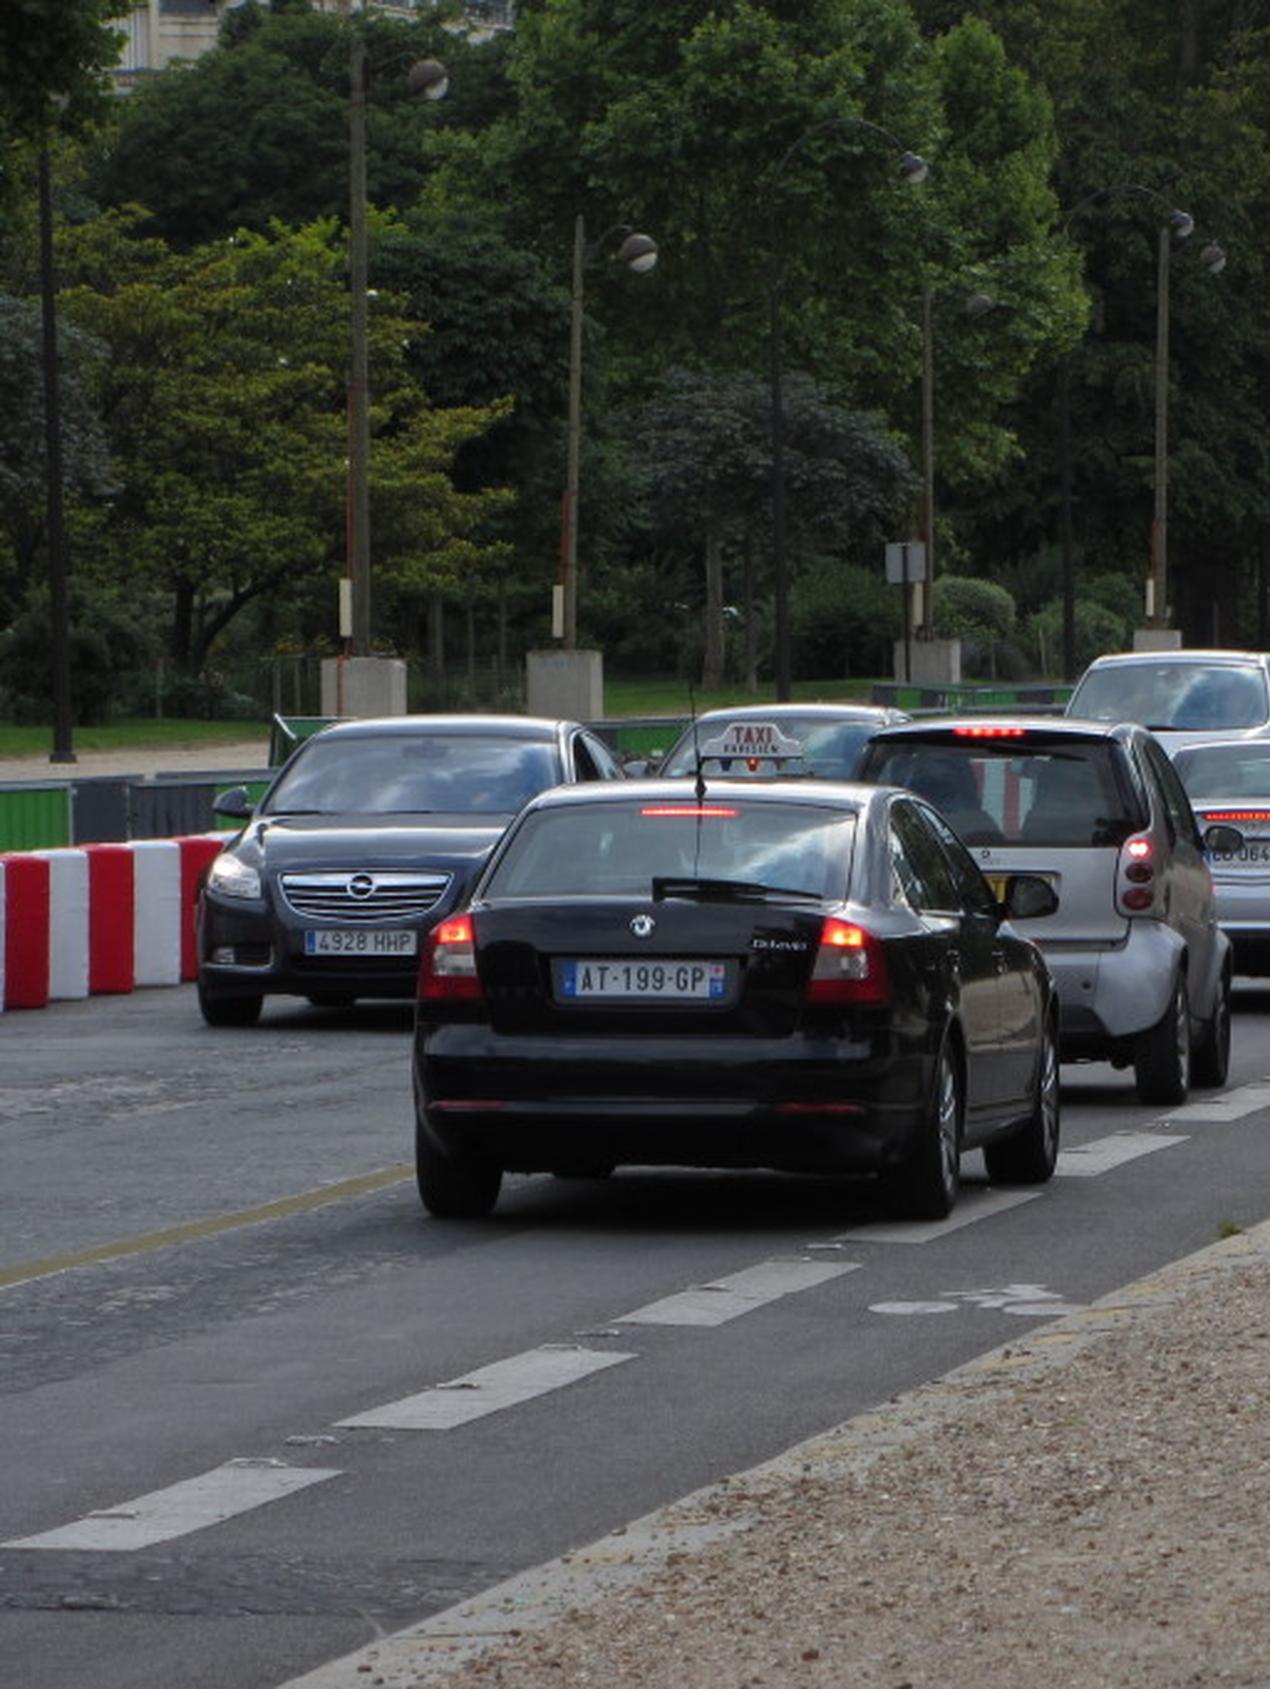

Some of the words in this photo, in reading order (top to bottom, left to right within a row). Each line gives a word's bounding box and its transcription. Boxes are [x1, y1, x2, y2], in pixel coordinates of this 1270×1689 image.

[733, 727, 772, 744] TAXI
[319, 931, 367, 952] 4928
[373, 931, 411, 952] HHP
[581, 966, 706, 992] AT-199-GP
